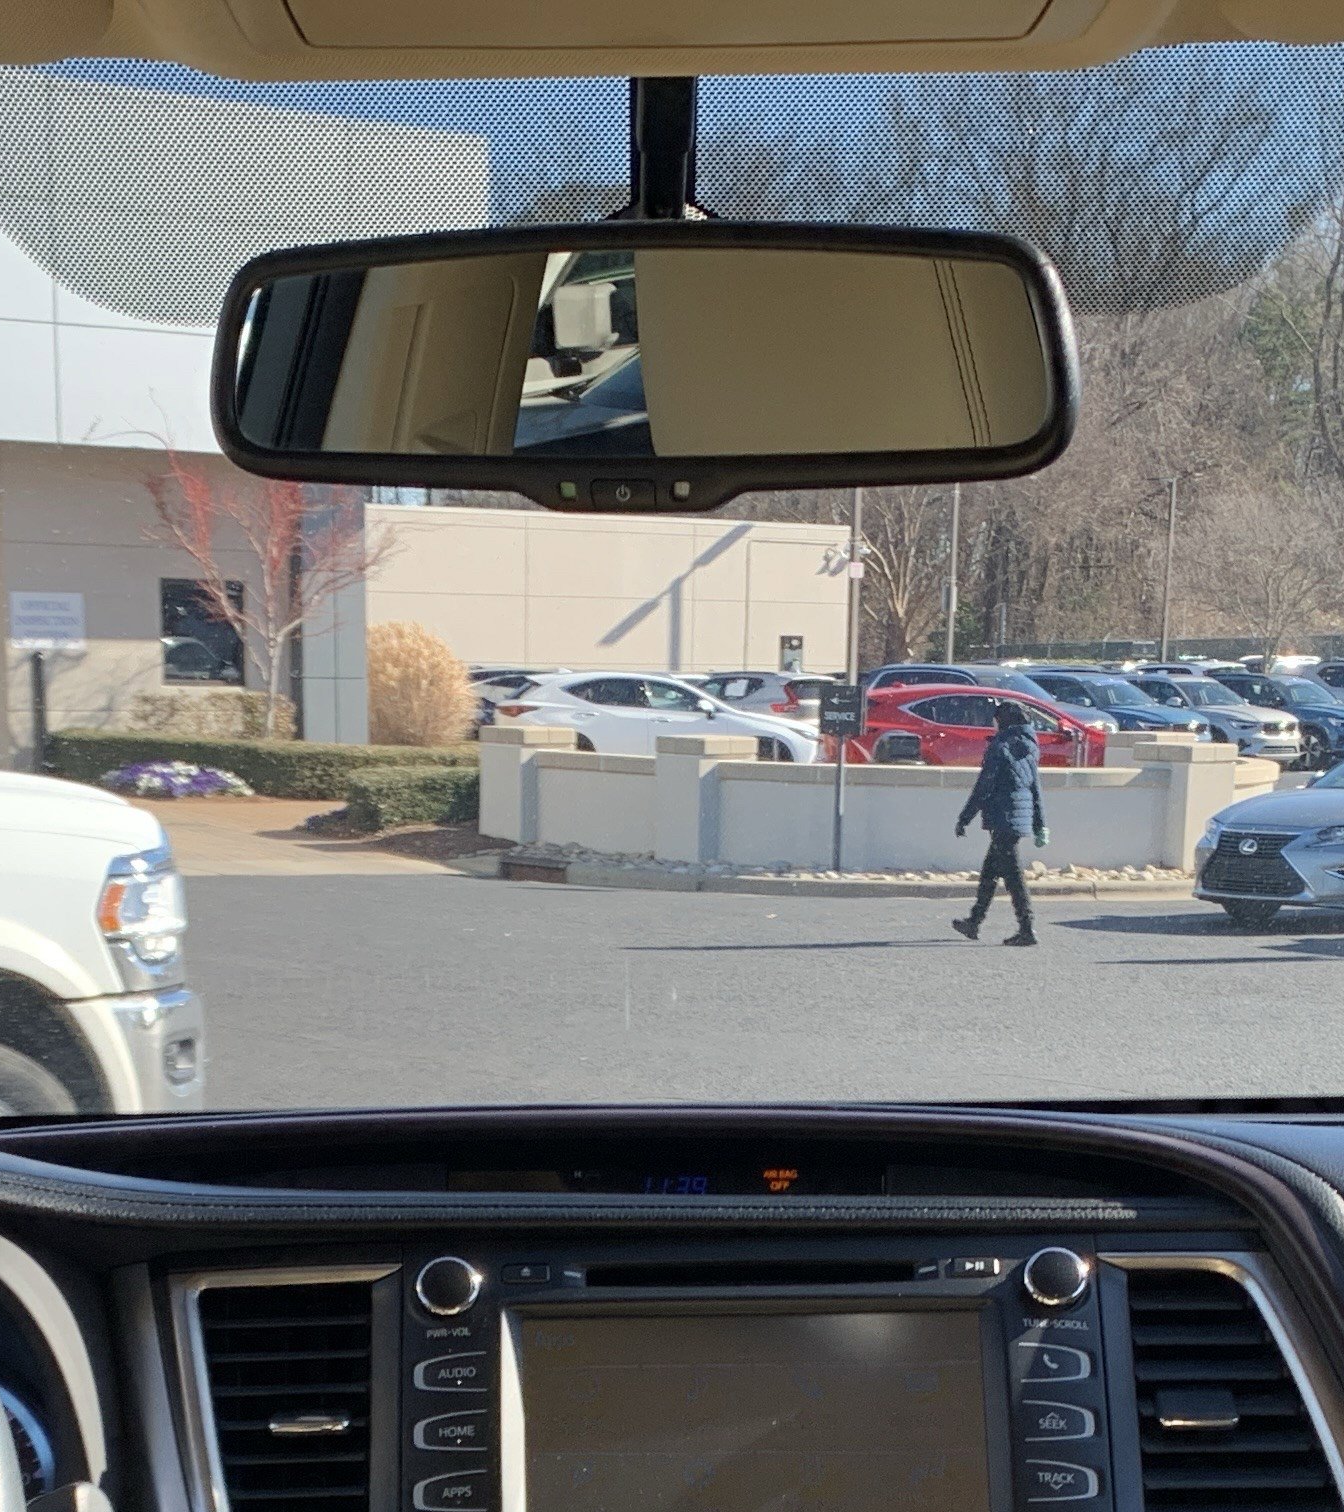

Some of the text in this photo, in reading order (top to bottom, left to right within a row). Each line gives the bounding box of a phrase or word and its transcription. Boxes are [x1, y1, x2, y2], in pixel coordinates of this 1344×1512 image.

[823, 711, 856, 721] SERVICE
[438, 1367, 476, 1379] AUDIO
[1038, 1418, 1067, 1430] SEEK
[438, 1425, 476, 1437] HOME
[1038, 1471, 1075, 1484] TRACK
[442, 1486, 473, 1499] APPS
